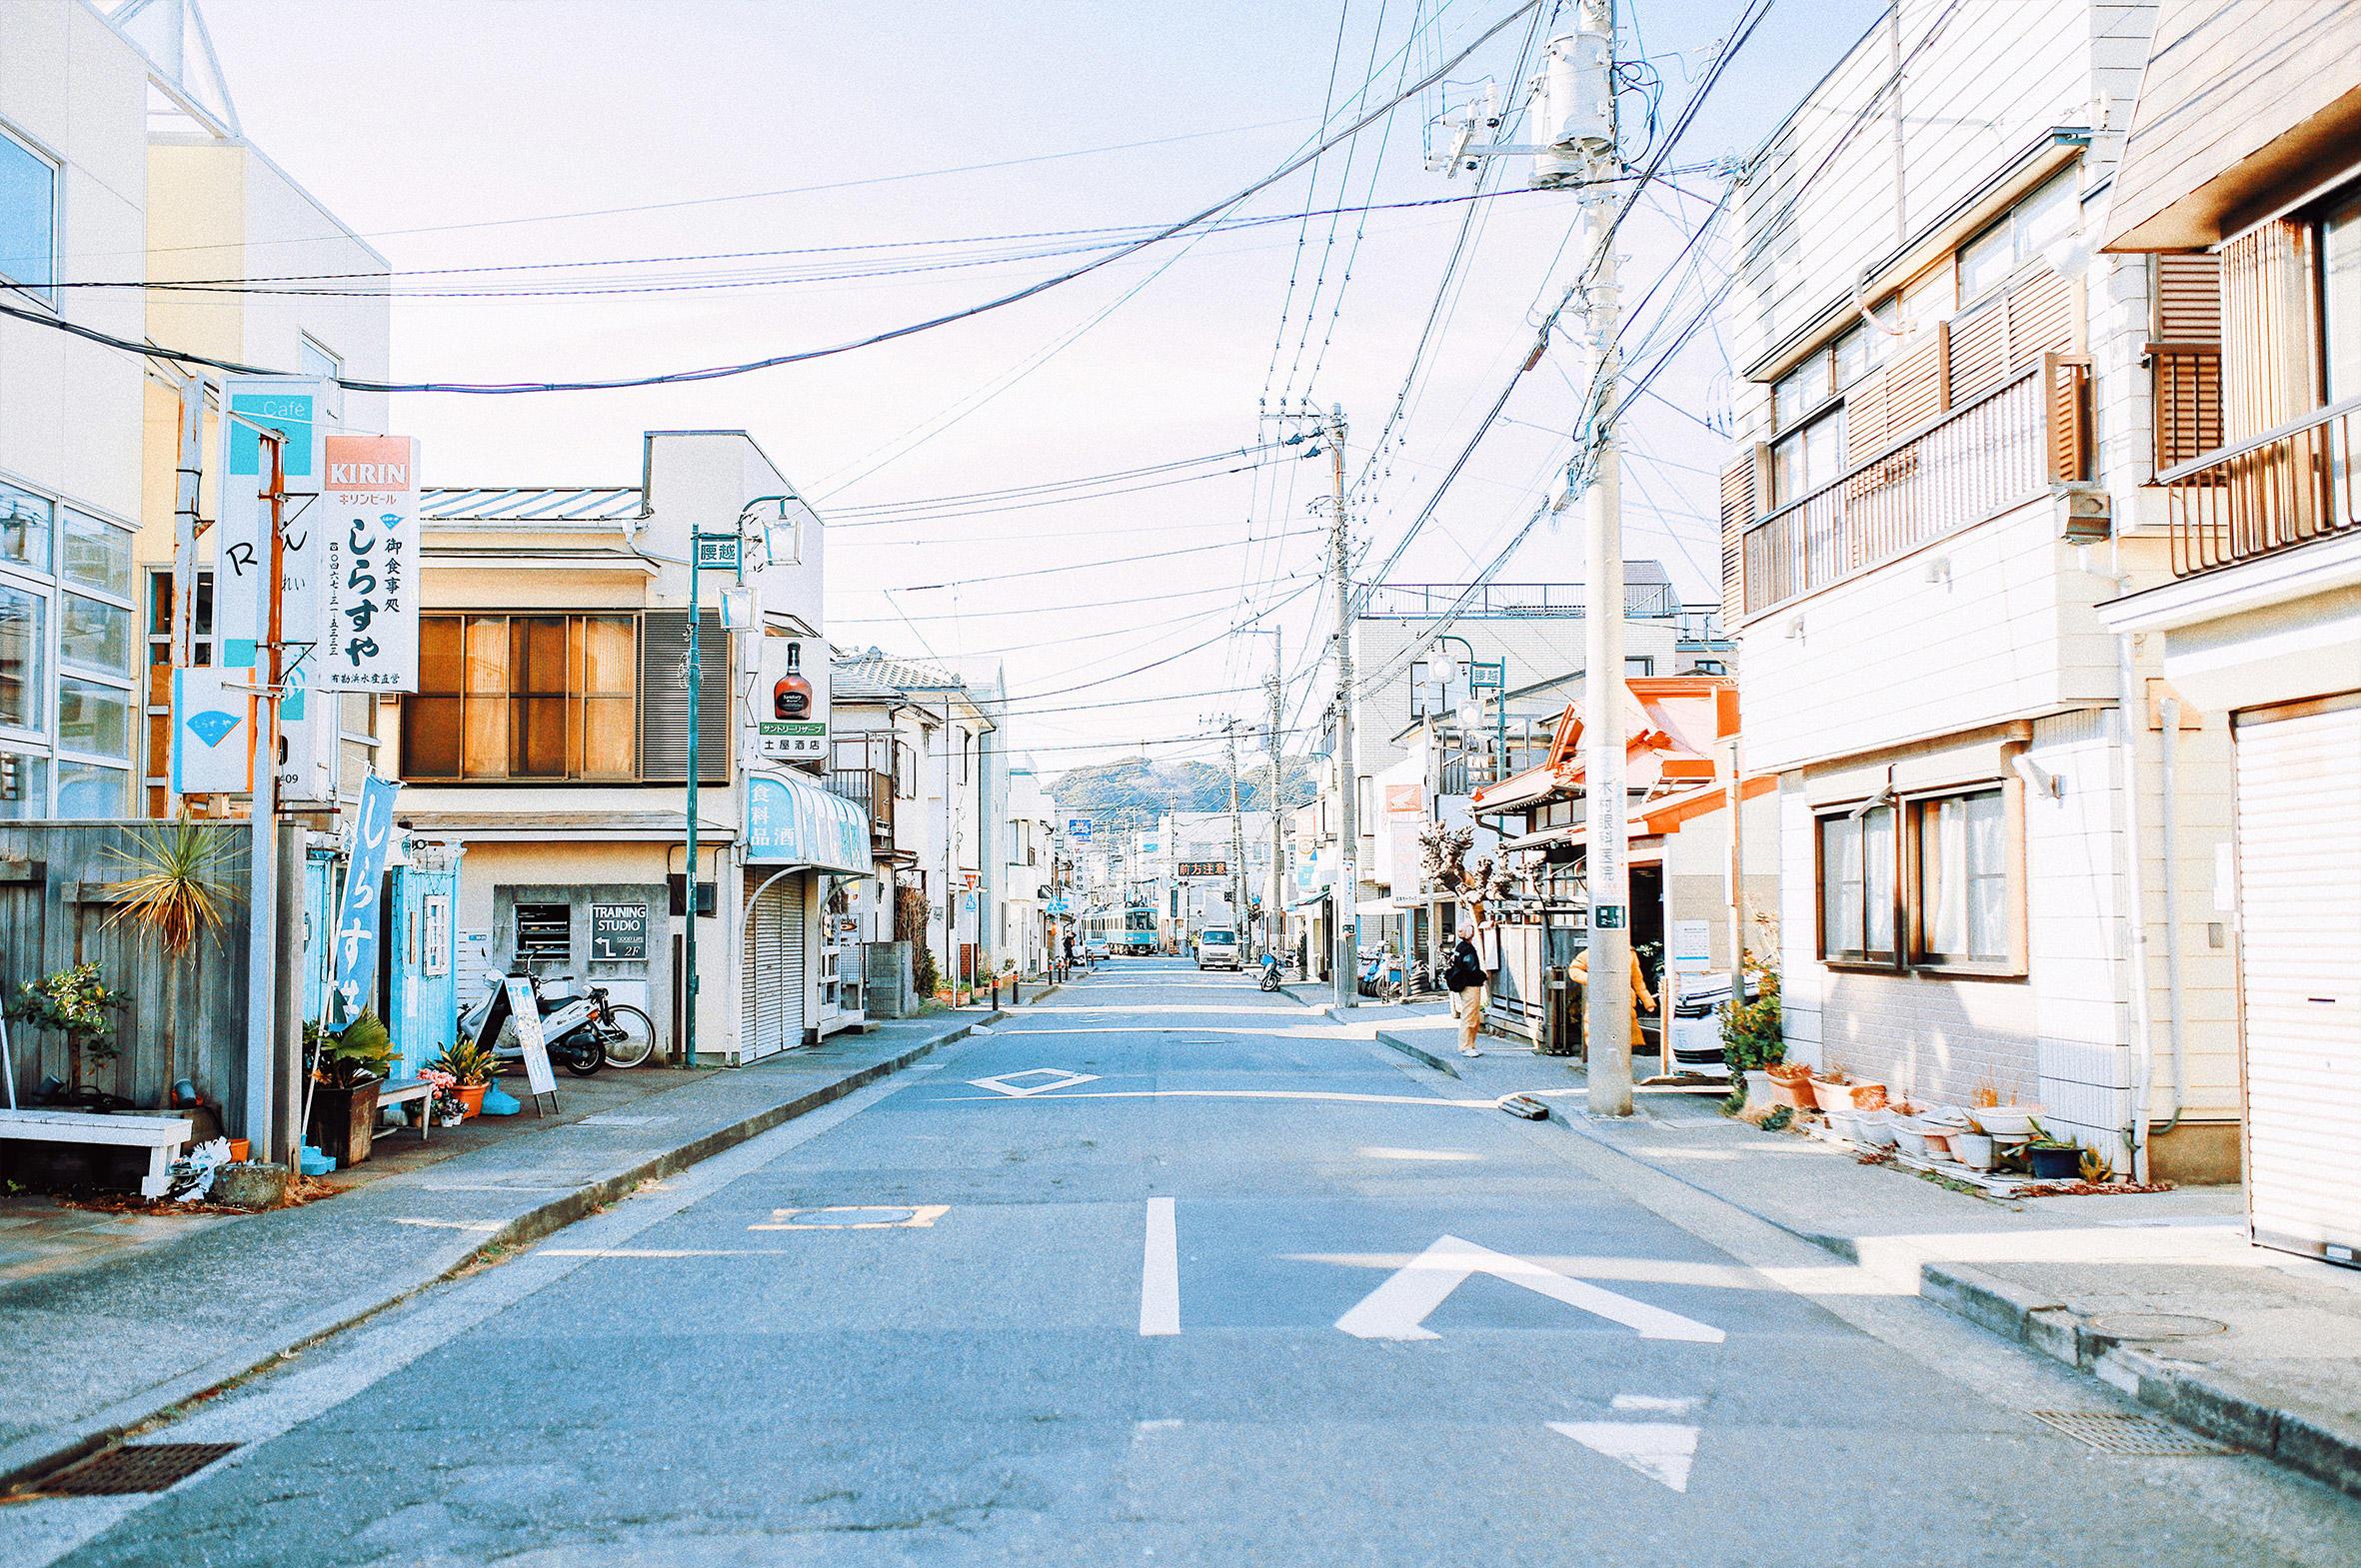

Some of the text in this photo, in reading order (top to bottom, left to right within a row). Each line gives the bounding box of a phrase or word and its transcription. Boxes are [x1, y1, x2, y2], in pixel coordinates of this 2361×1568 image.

[330, 462, 406, 485] KIRIN
[339, 494, 397, 506] キリンビール
[701, 543, 736, 561] 腰越
[384, 537, 403, 613] 御食事処
[345, 518, 380, 668] しらすや
[764, 740, 820, 751] 土屋酒店
[750, 784, 770, 846] 食料品
[1180, 862, 1226, 876] 前方注意
[593, 906, 646, 918] TRAINING
[598, 919, 641, 931] STUDIO
[624, 945, 641, 956] 2F
